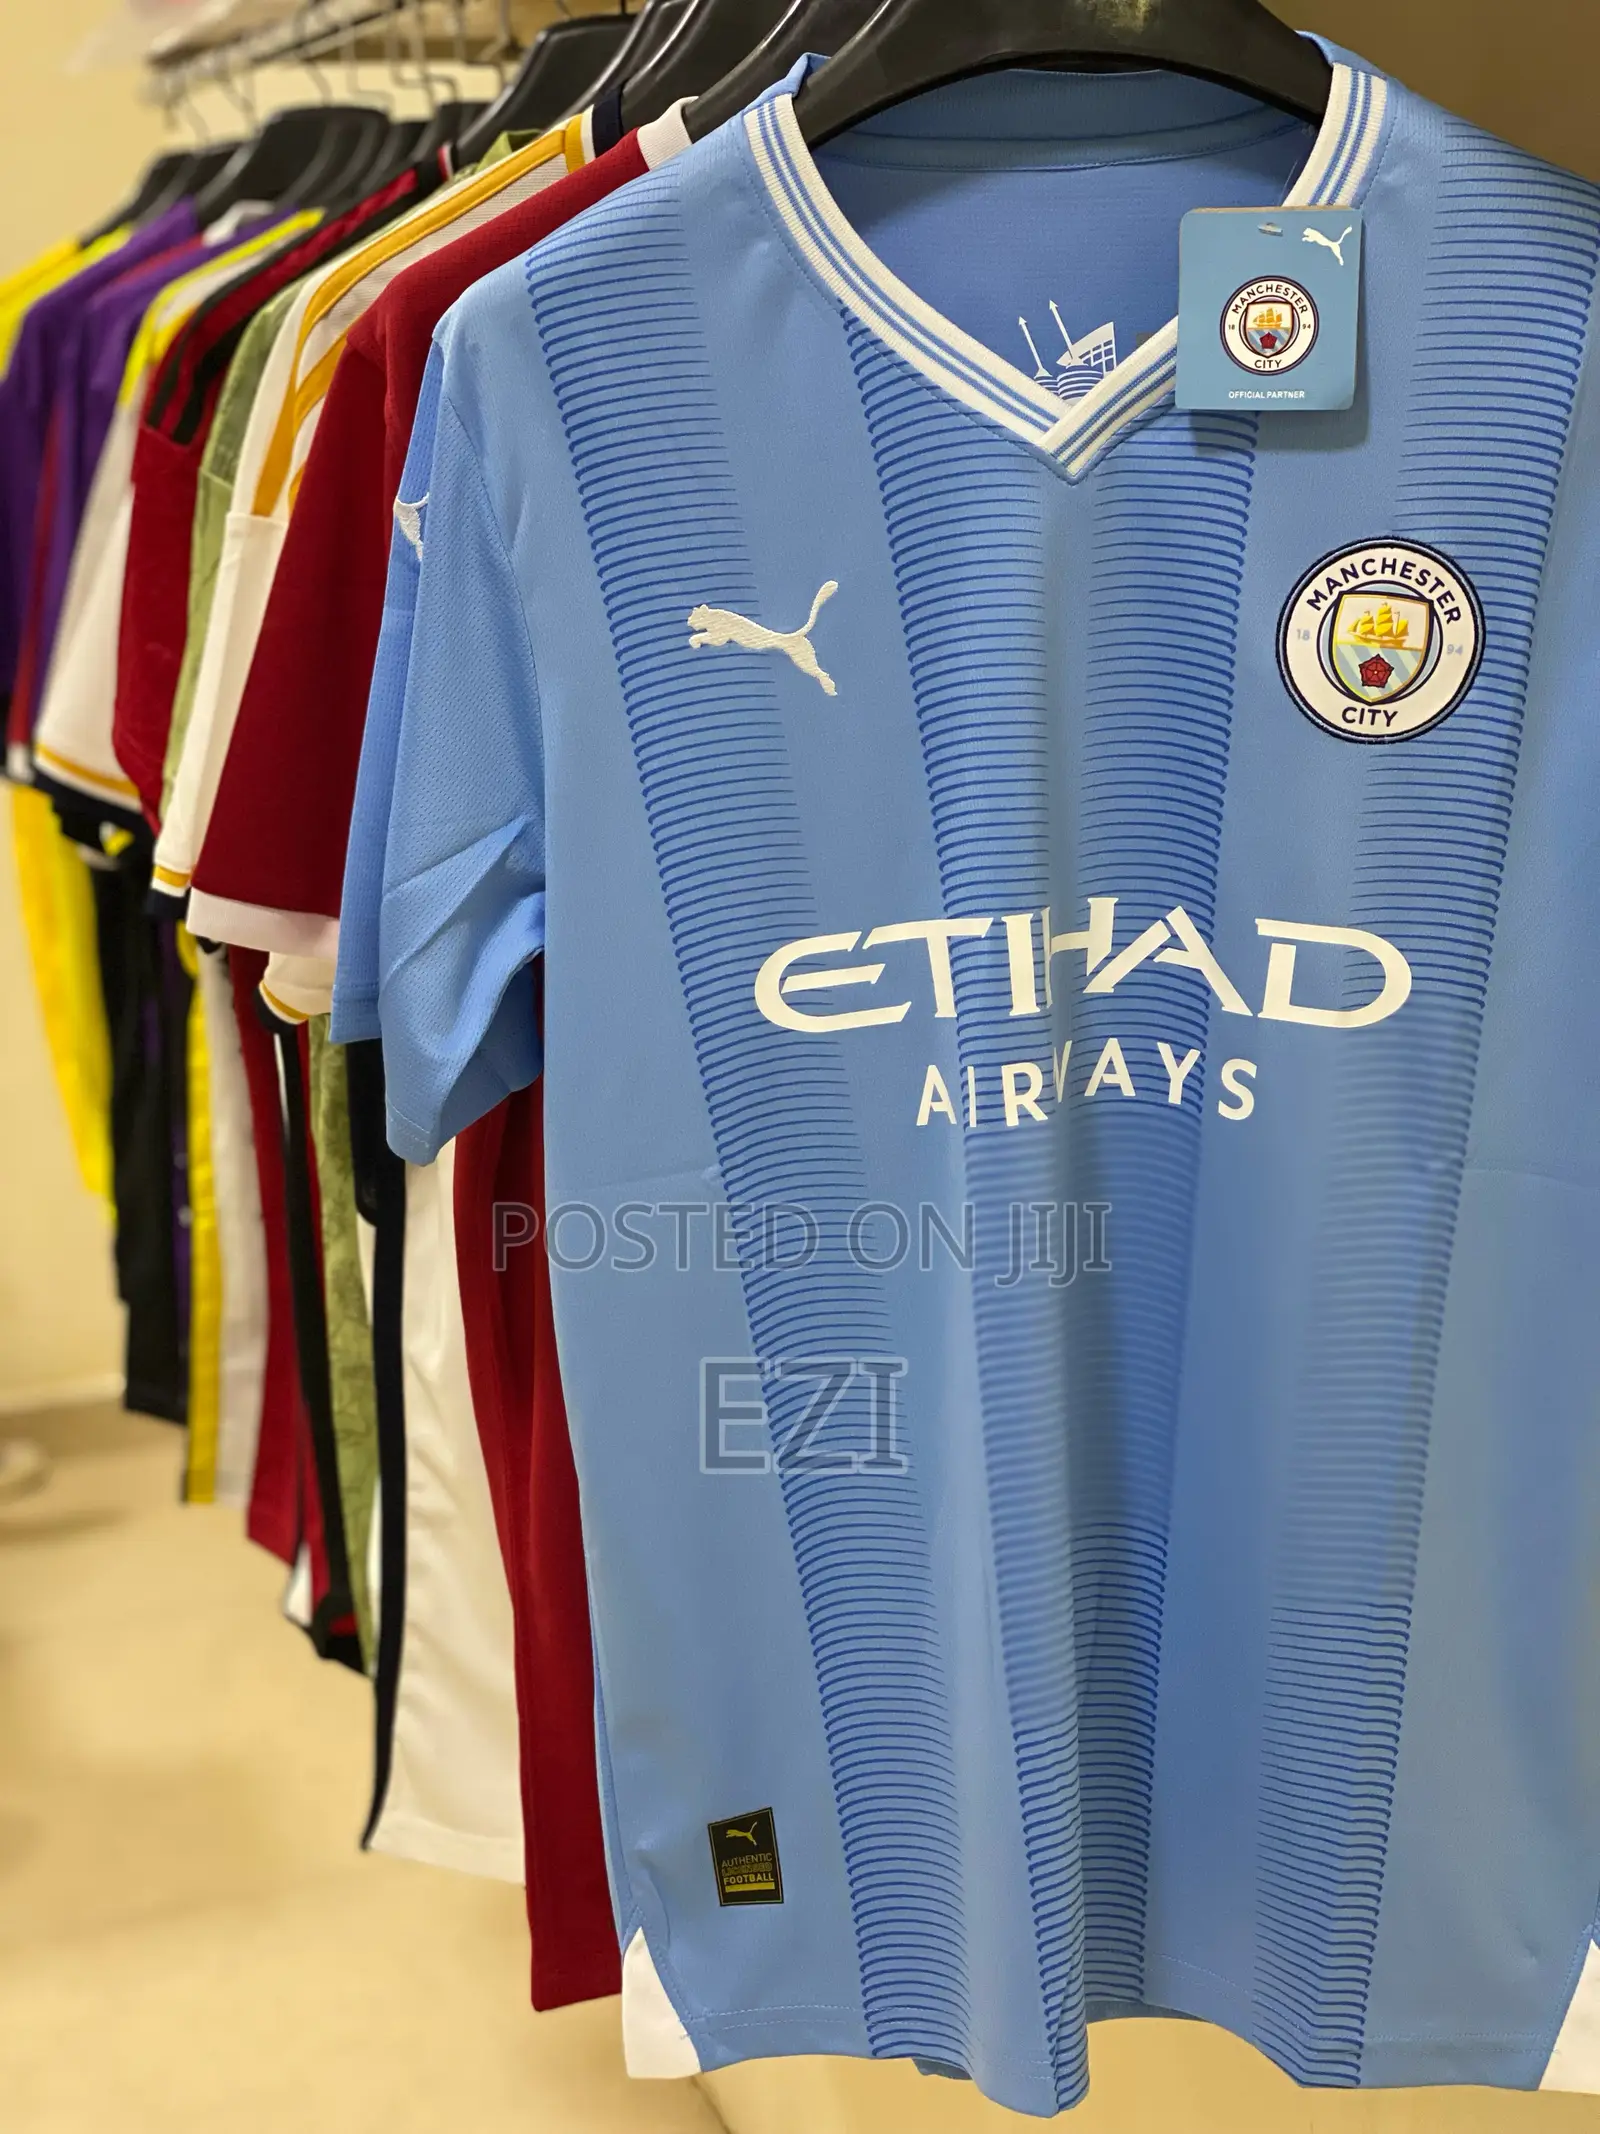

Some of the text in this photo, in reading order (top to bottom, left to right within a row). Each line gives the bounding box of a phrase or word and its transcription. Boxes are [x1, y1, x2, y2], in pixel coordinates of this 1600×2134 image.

[1232, 284, 1308, 314] MANCHESTER
[1228, 323, 1236, 331] 18
[1302, 322, 1311, 331] 94
[1254, 359, 1283, 369] CITY
[1228, 390, 1305, 399] OFFICIAL PARTNER
[1306, 557, 1462, 625] MANCHESTER
[1341, 706, 1398, 728] CITY
[754, 896, 1413, 1033] ETIHAD
[722, 1853, 772, 1868] AUTHENTIC
[724, 1873, 774, 1885] FOOTBALL
